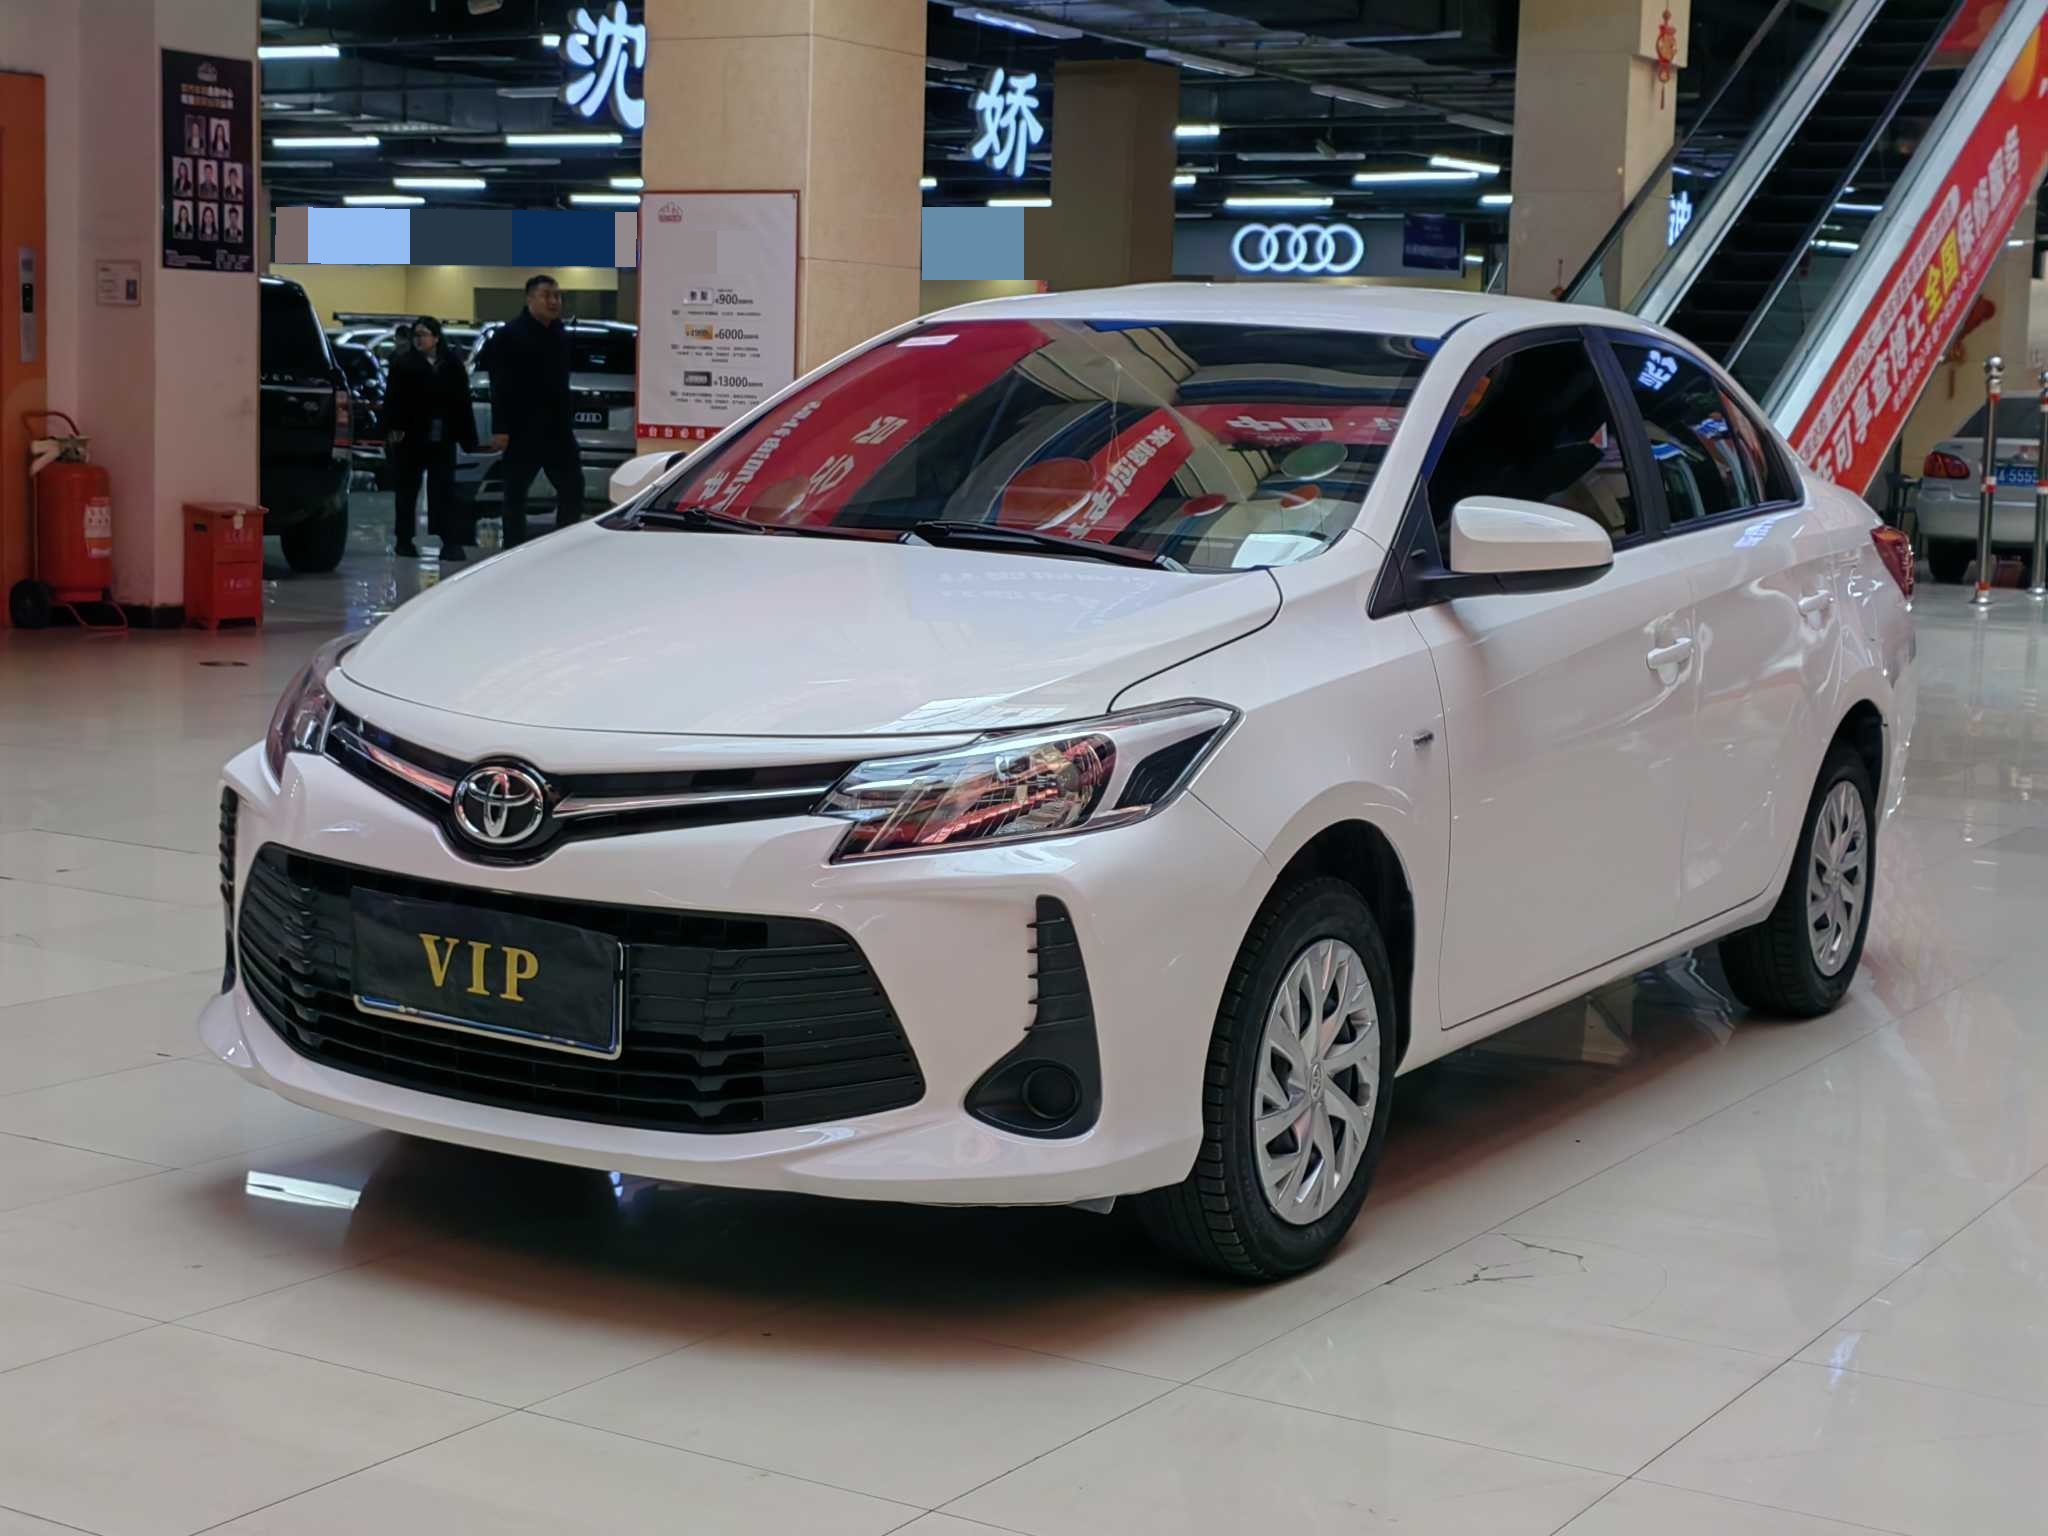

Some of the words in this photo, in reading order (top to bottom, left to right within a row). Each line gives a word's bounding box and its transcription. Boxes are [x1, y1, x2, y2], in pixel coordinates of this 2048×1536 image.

[565, 0, 645, 130] 沈
[970, 66, 1045, 178] 娇
[418, 932, 540, 1002] VIP
